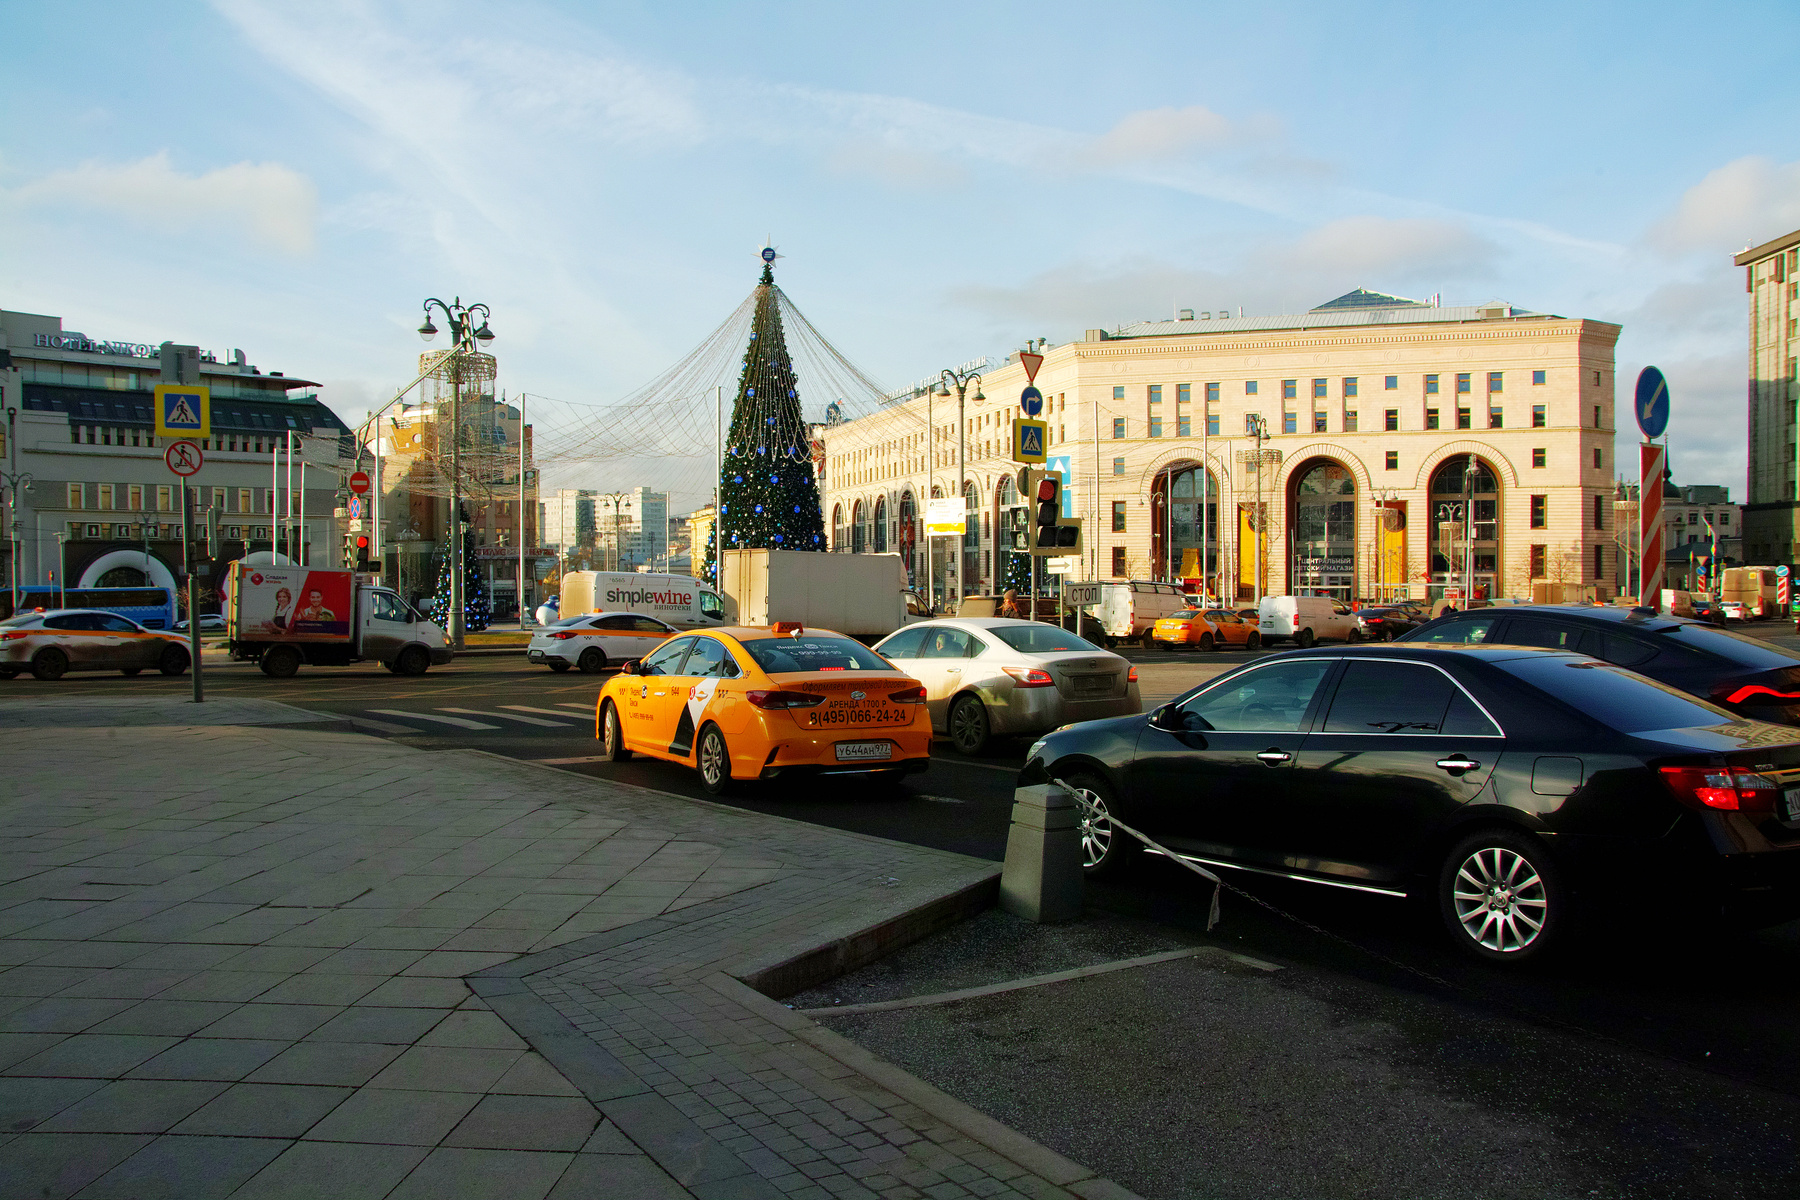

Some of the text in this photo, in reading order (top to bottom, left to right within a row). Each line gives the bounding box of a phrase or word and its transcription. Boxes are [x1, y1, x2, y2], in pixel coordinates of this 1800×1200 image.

[35, 333, 98, 351] HOTEL
[606, 588, 692, 608] simplewine
[1071, 587, 1097, 602] СТОП
[802, 679, 908, 693] Оформляем трудовой договор
[829, 700, 860, 710] АРЕНДА
[863, 700, 880, 708] 1700
[809, 709, 906, 727] 8(495)066-24-24
[839, 745, 875, 756] У644АН
